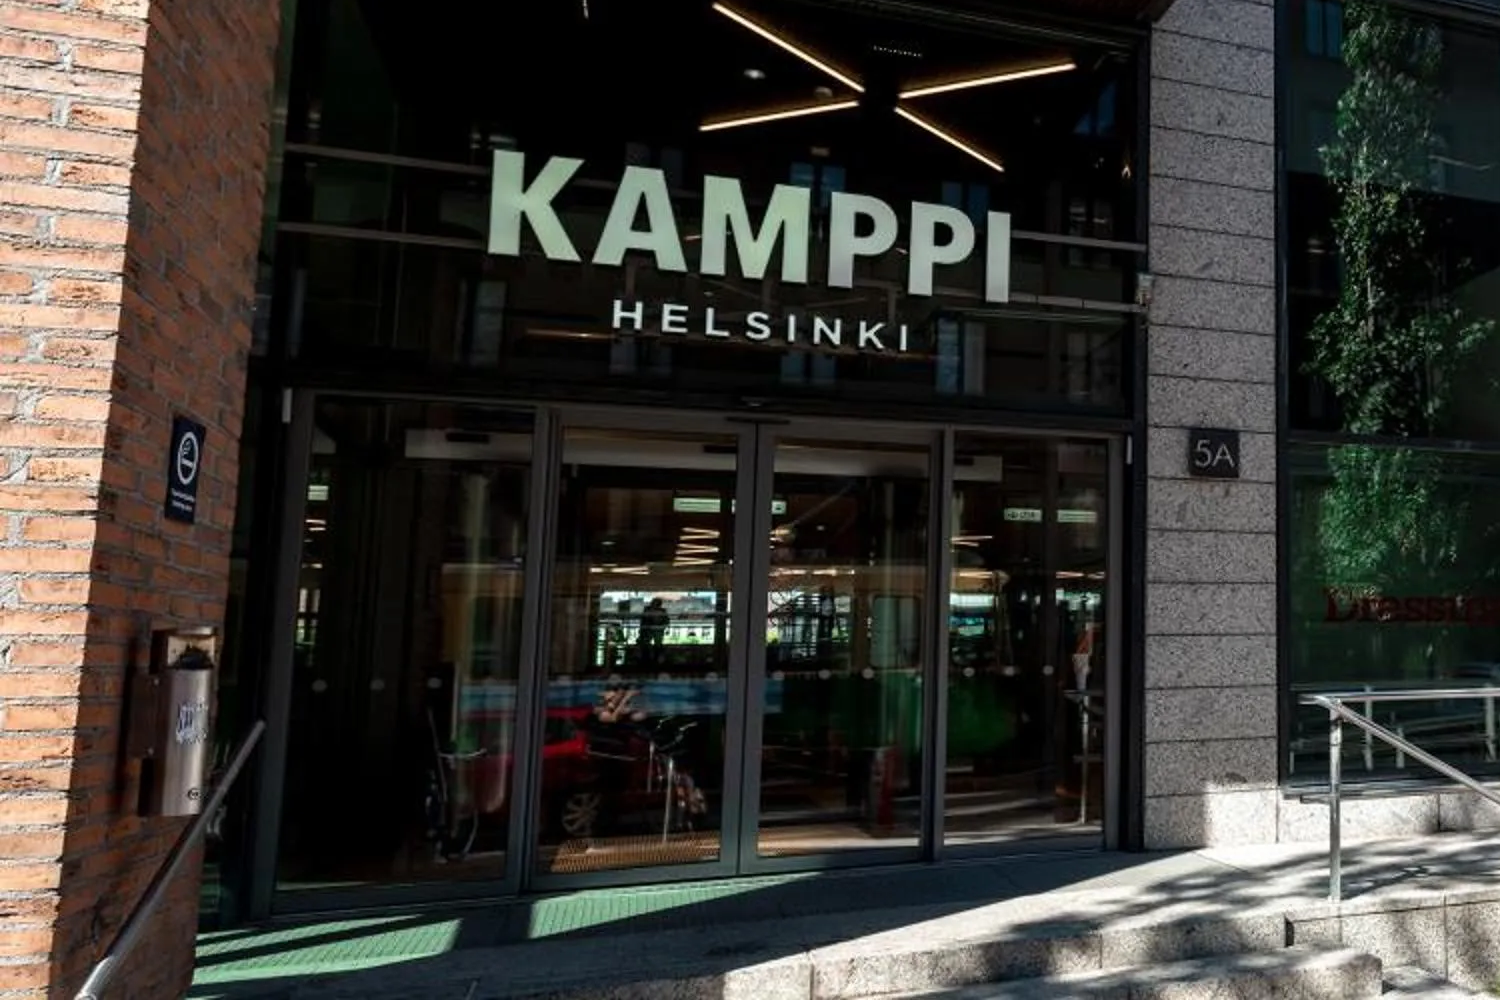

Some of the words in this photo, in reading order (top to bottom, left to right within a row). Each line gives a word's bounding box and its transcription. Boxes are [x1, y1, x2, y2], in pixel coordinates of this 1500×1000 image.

[487, 148, 1011, 303] KAMPPI
[611, 298, 908, 351] HELSINKI
[1194, 439, 1235, 468] 5A
